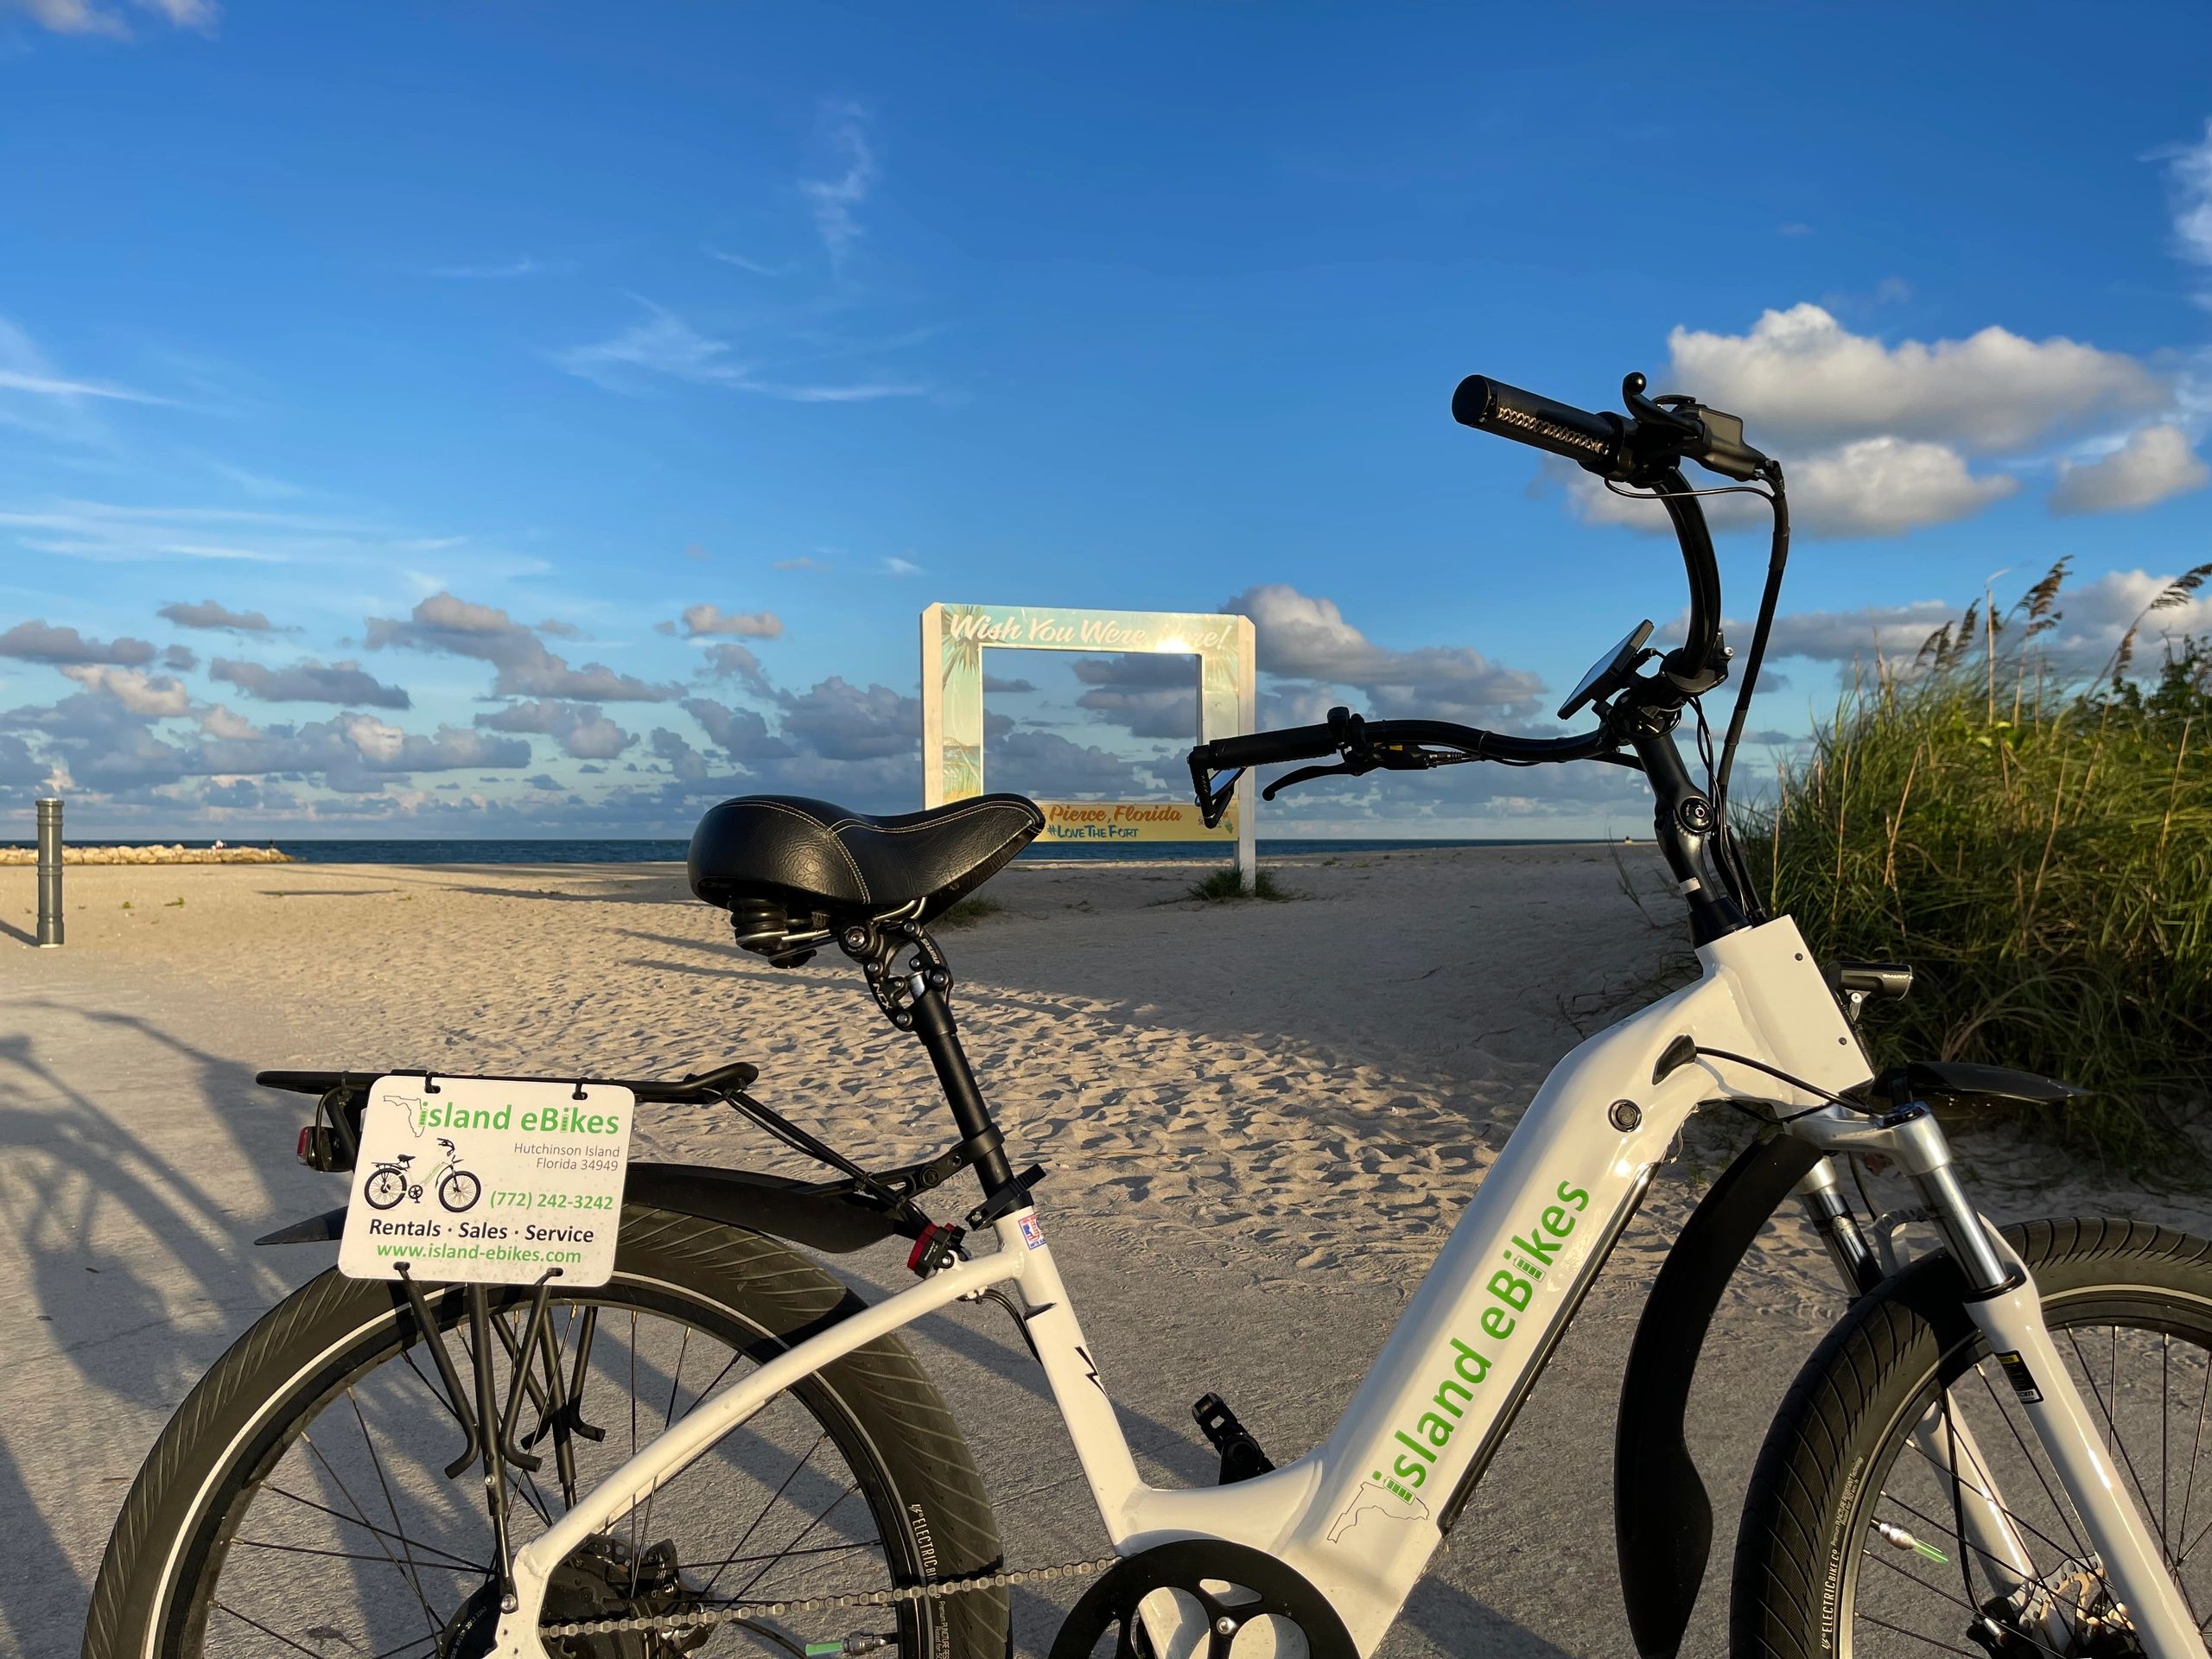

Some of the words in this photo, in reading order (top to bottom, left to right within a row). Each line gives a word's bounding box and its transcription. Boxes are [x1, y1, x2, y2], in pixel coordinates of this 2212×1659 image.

[950, 613, 1022, 640] Wish
[1028, 617, 1076, 643] You
[1080, 619, 1147, 645] Were
[1158, 623, 1232, 651] re!
[1049, 804, 1111, 823] Pierce,
[1113, 805, 1182, 822] Florida
[873, 982, 893, 1010] NCX
[418, 1101, 512, 1131] island
[520, 1106, 620, 1135] eBikes
[514, 1142, 582, 1156] Hutchinson
[585, 1145, 620, 1158] Island
[537, 1157, 578, 1171] Florida
[581, 1159, 619, 1172] 34949
[490, 1190, 532, 1210] (772)
[537, 1192, 613, 1211] 242-3242
[369, 1218, 442, 1237] Rentals
[458, 1221, 508, 1240] Sales
[524, 1224, 594, 1243] Service
[377, 1243, 582, 1263] www.island-ebikes.com
[1371, 1338, 1493, 1505] island
[1480, 1179, 1590, 1340] eBikes
[912, 1517, 938, 1567] ELECTRIC
[925, 1567, 938, 1584] BIK
[1828, 1562, 1839, 1581] BIKE
[1821, 1580, 1836, 1633] ELECTRIC
